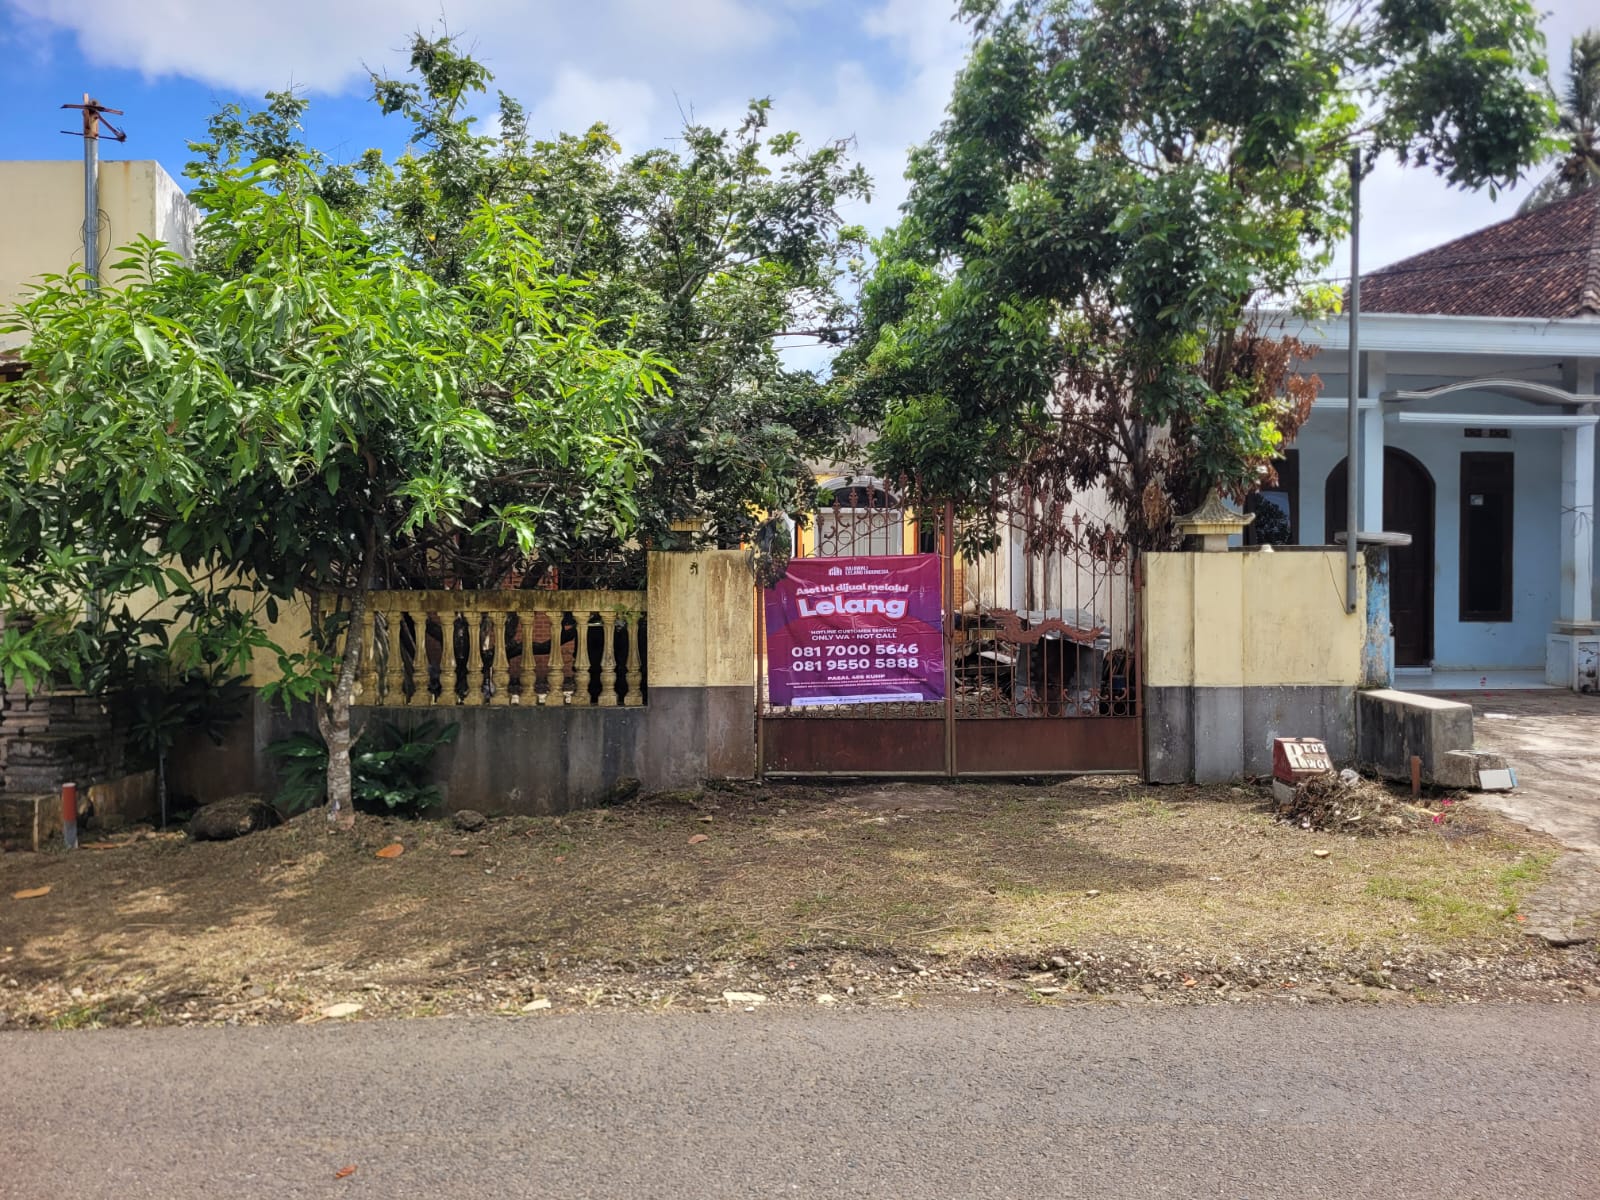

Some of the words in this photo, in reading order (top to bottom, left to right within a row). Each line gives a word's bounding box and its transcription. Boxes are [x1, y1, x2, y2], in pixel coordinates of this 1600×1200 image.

[796, 586, 820, 596] Aset
[820, 584, 834, 593] ini
[835, 582, 867, 593] dijual
[798, 595, 906, 618] Lelang
[791, 646, 821, 657] 081
[825, 644, 871, 657] 7000
[875, 643, 919, 655] 5646
[792, 660, 822, 672] 081
[826, 658, 870, 670] 9550
[875, 657, 919, 669] 5888
